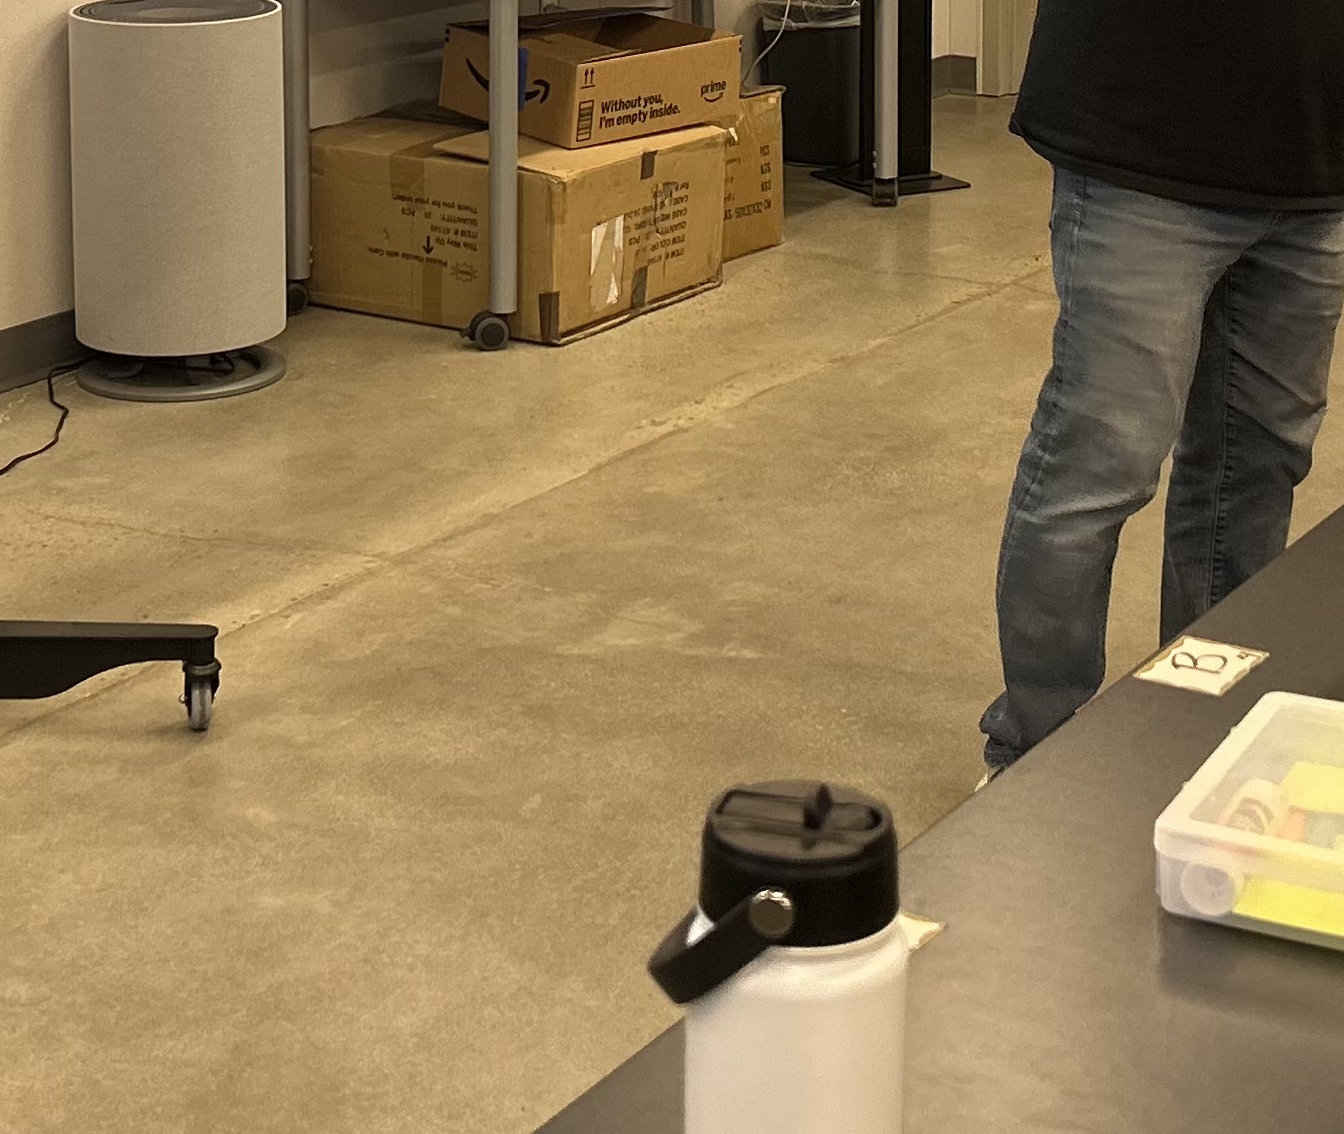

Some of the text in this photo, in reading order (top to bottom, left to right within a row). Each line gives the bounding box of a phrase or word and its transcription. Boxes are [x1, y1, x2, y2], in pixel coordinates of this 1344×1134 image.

[700, 80, 727, 98] prime
[601, 93, 664, 114] Without you,
[599, 102, 681, 129] I'm empty inside.
